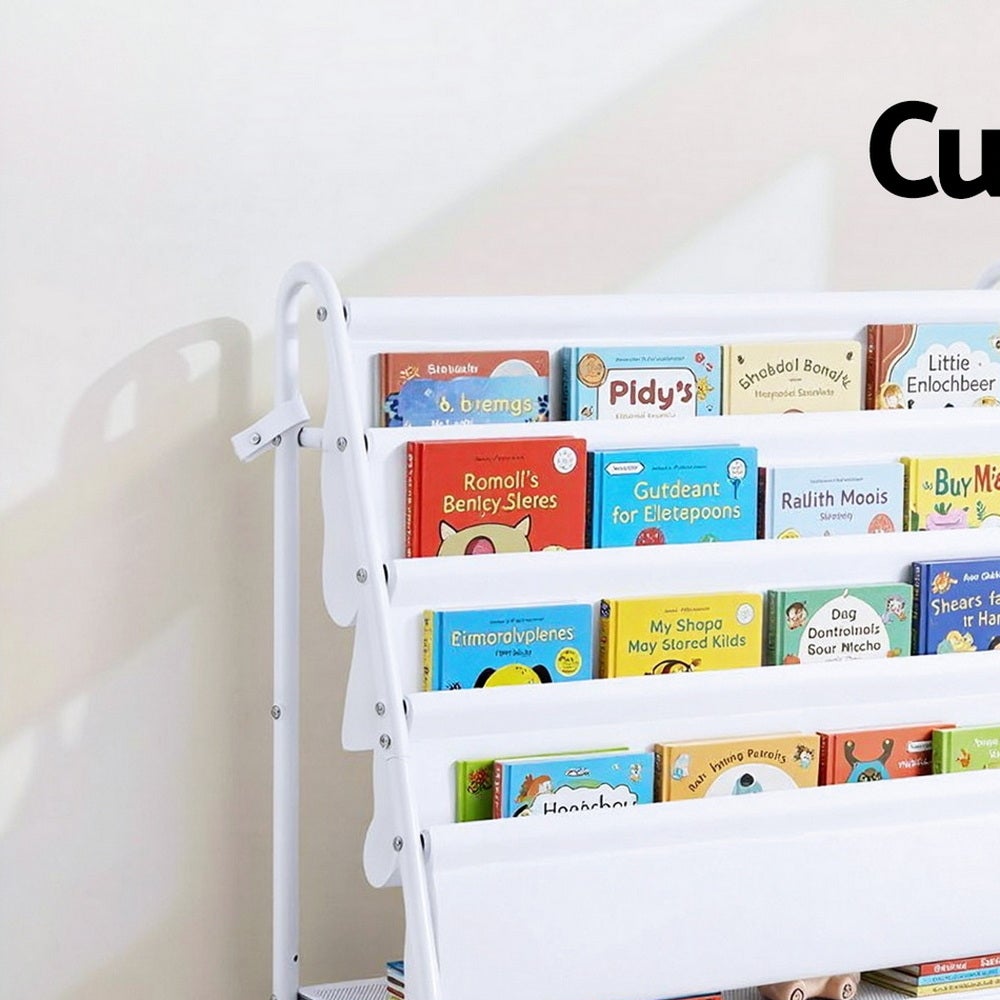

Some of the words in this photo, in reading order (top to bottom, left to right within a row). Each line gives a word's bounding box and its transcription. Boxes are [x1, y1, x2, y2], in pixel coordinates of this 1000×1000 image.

[907, 374, 997, 393] Enlochbeer
[610, 378, 693, 410] Pidy's
[612, 505, 639, 524] for
[931, 595, 982, 616] Shears
[650, 620, 672, 635] My
[628, 639, 658, 656] May
[712, 633, 747, 649] Kilds
[807, 643, 837, 656] Sour
